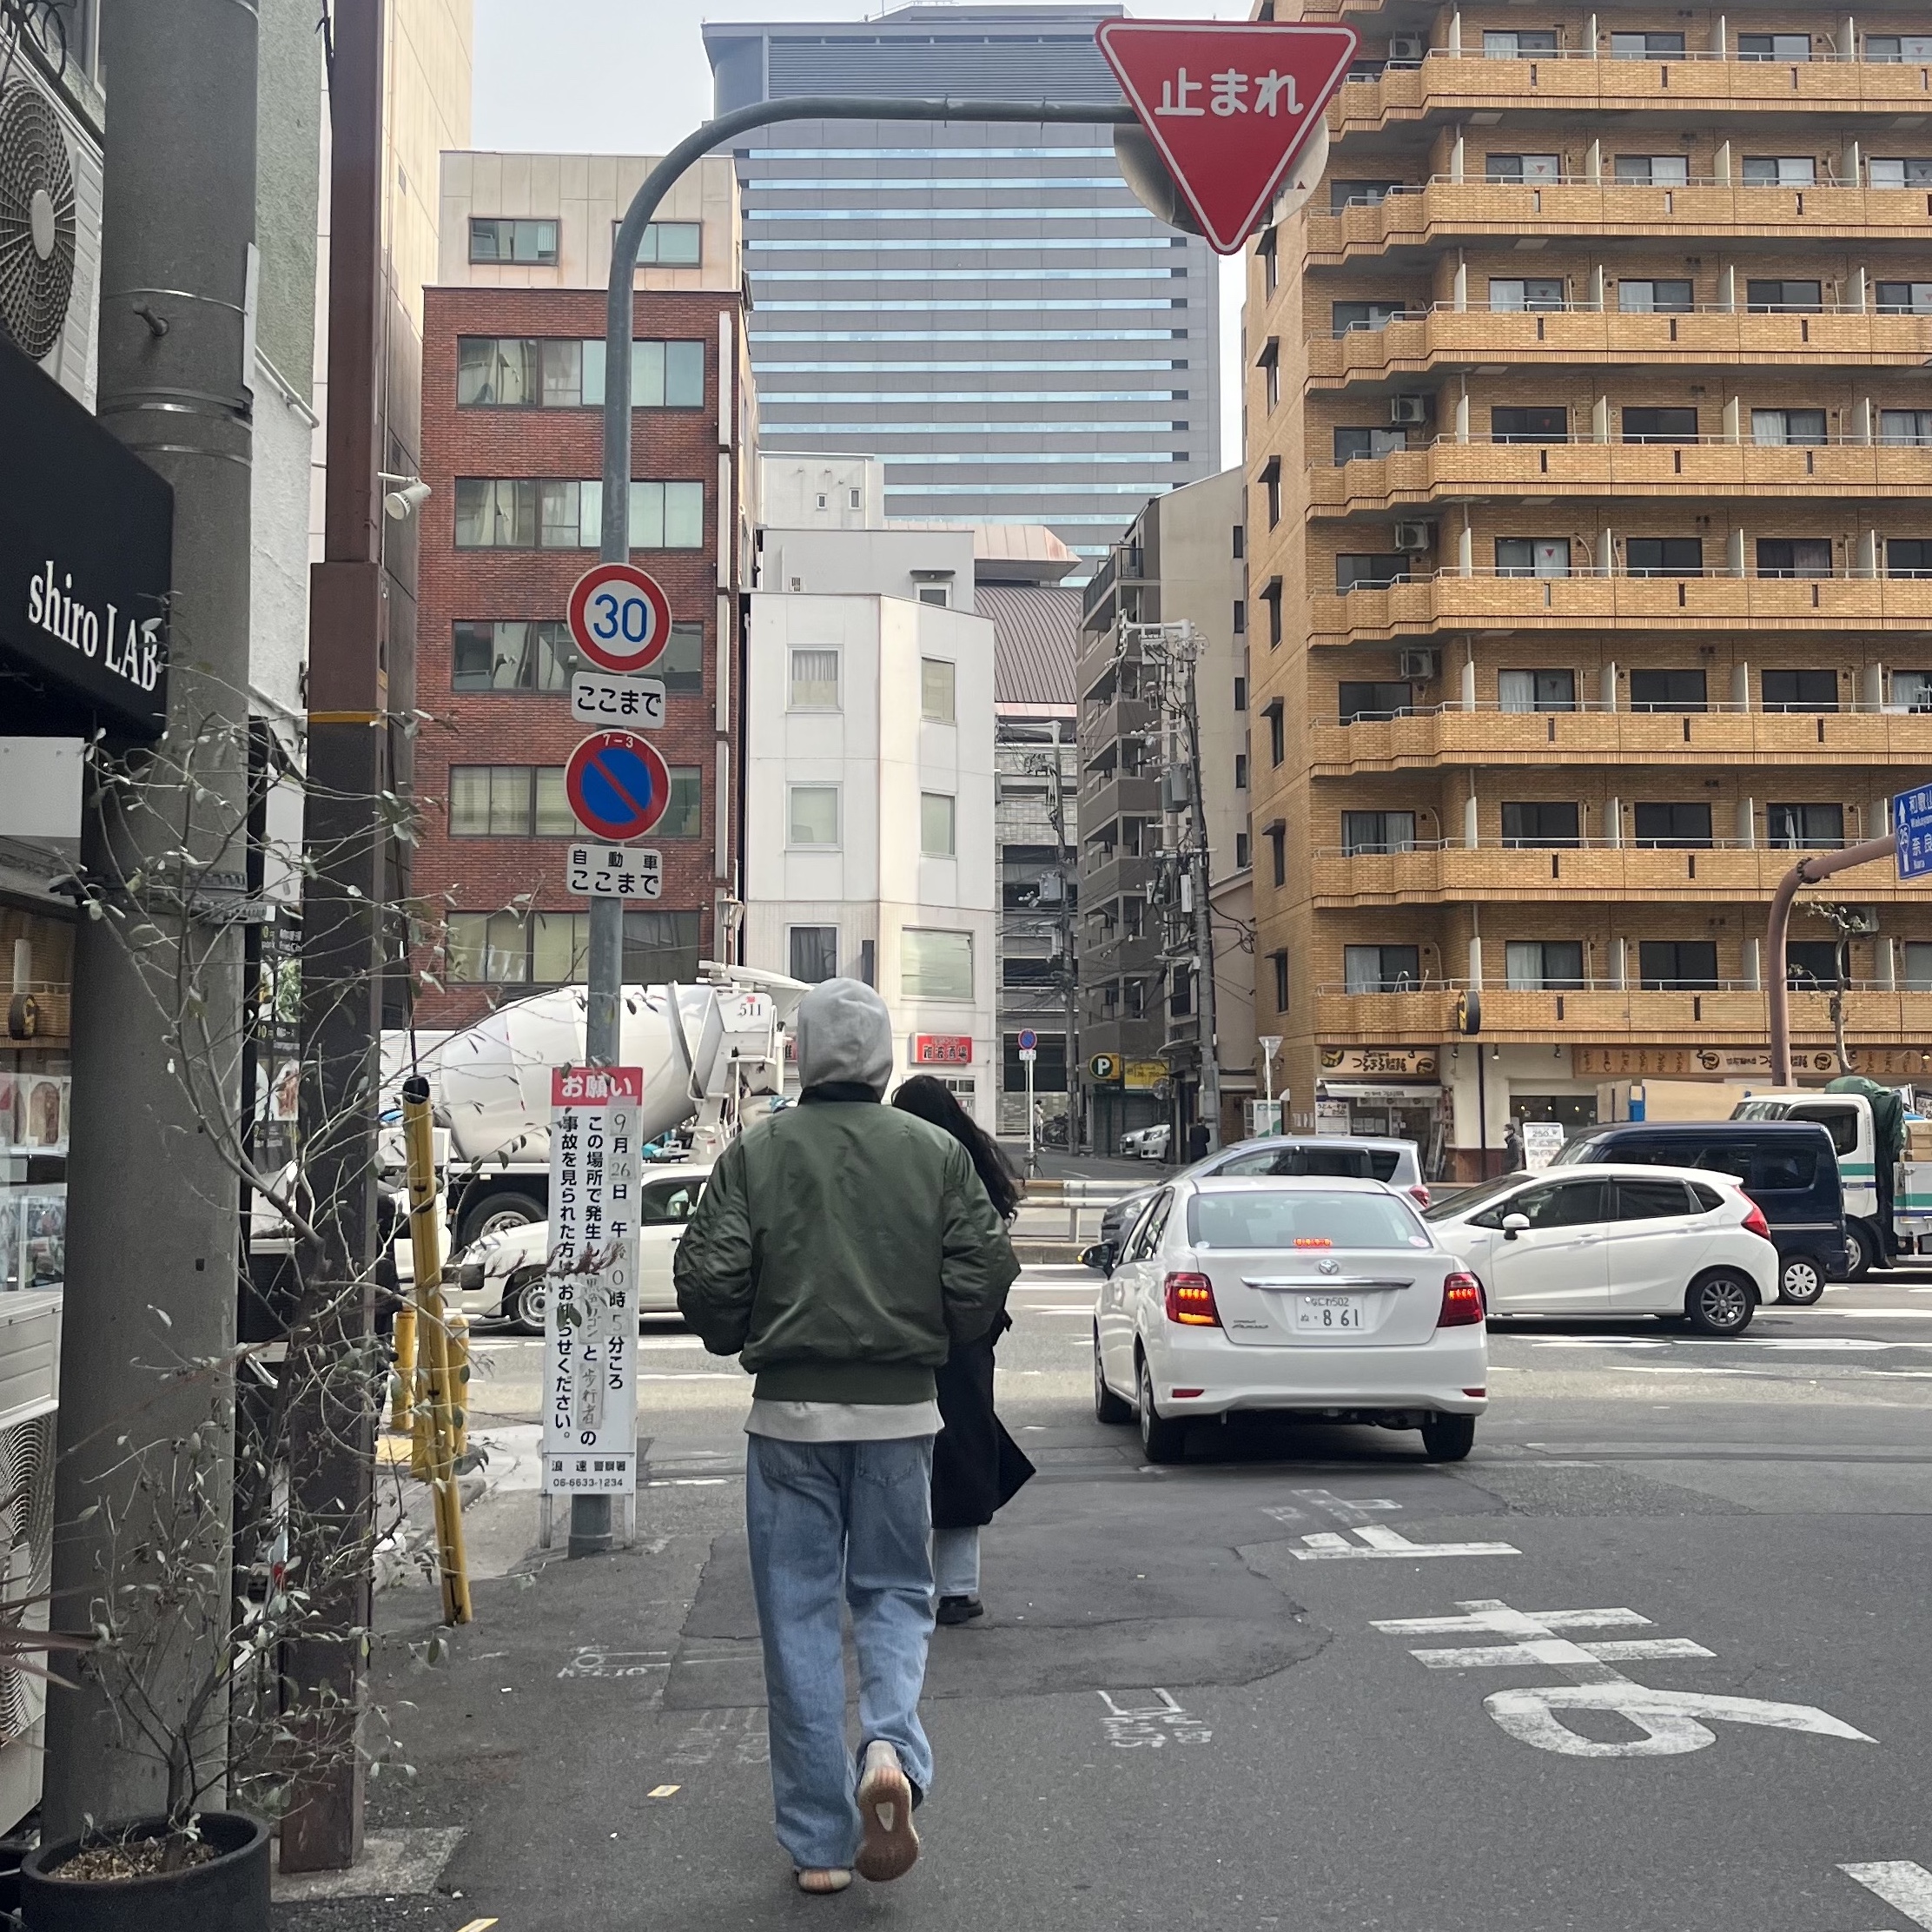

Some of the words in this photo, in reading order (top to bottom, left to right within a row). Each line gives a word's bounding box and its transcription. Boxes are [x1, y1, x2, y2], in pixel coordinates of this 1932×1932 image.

[1154, 67, 1304, 117] 止まれ
[29, 560, 99, 658] shiro
[104, 603, 158, 691] LAB
[593, 593, 648, 643] 30
[577, 685, 662, 718] ここまで
[603, 733, 634, 749] 7-3
[572, 849, 658, 870] 自動車
[572, 870, 659, 896] ここまで
[737, 1002, 761, 1016] 511
[1097, 1057, 1110, 1075] P
[561, 1075, 632, 1097] お願い
[553, 1478, 623, 1487] 06-6633-1234
